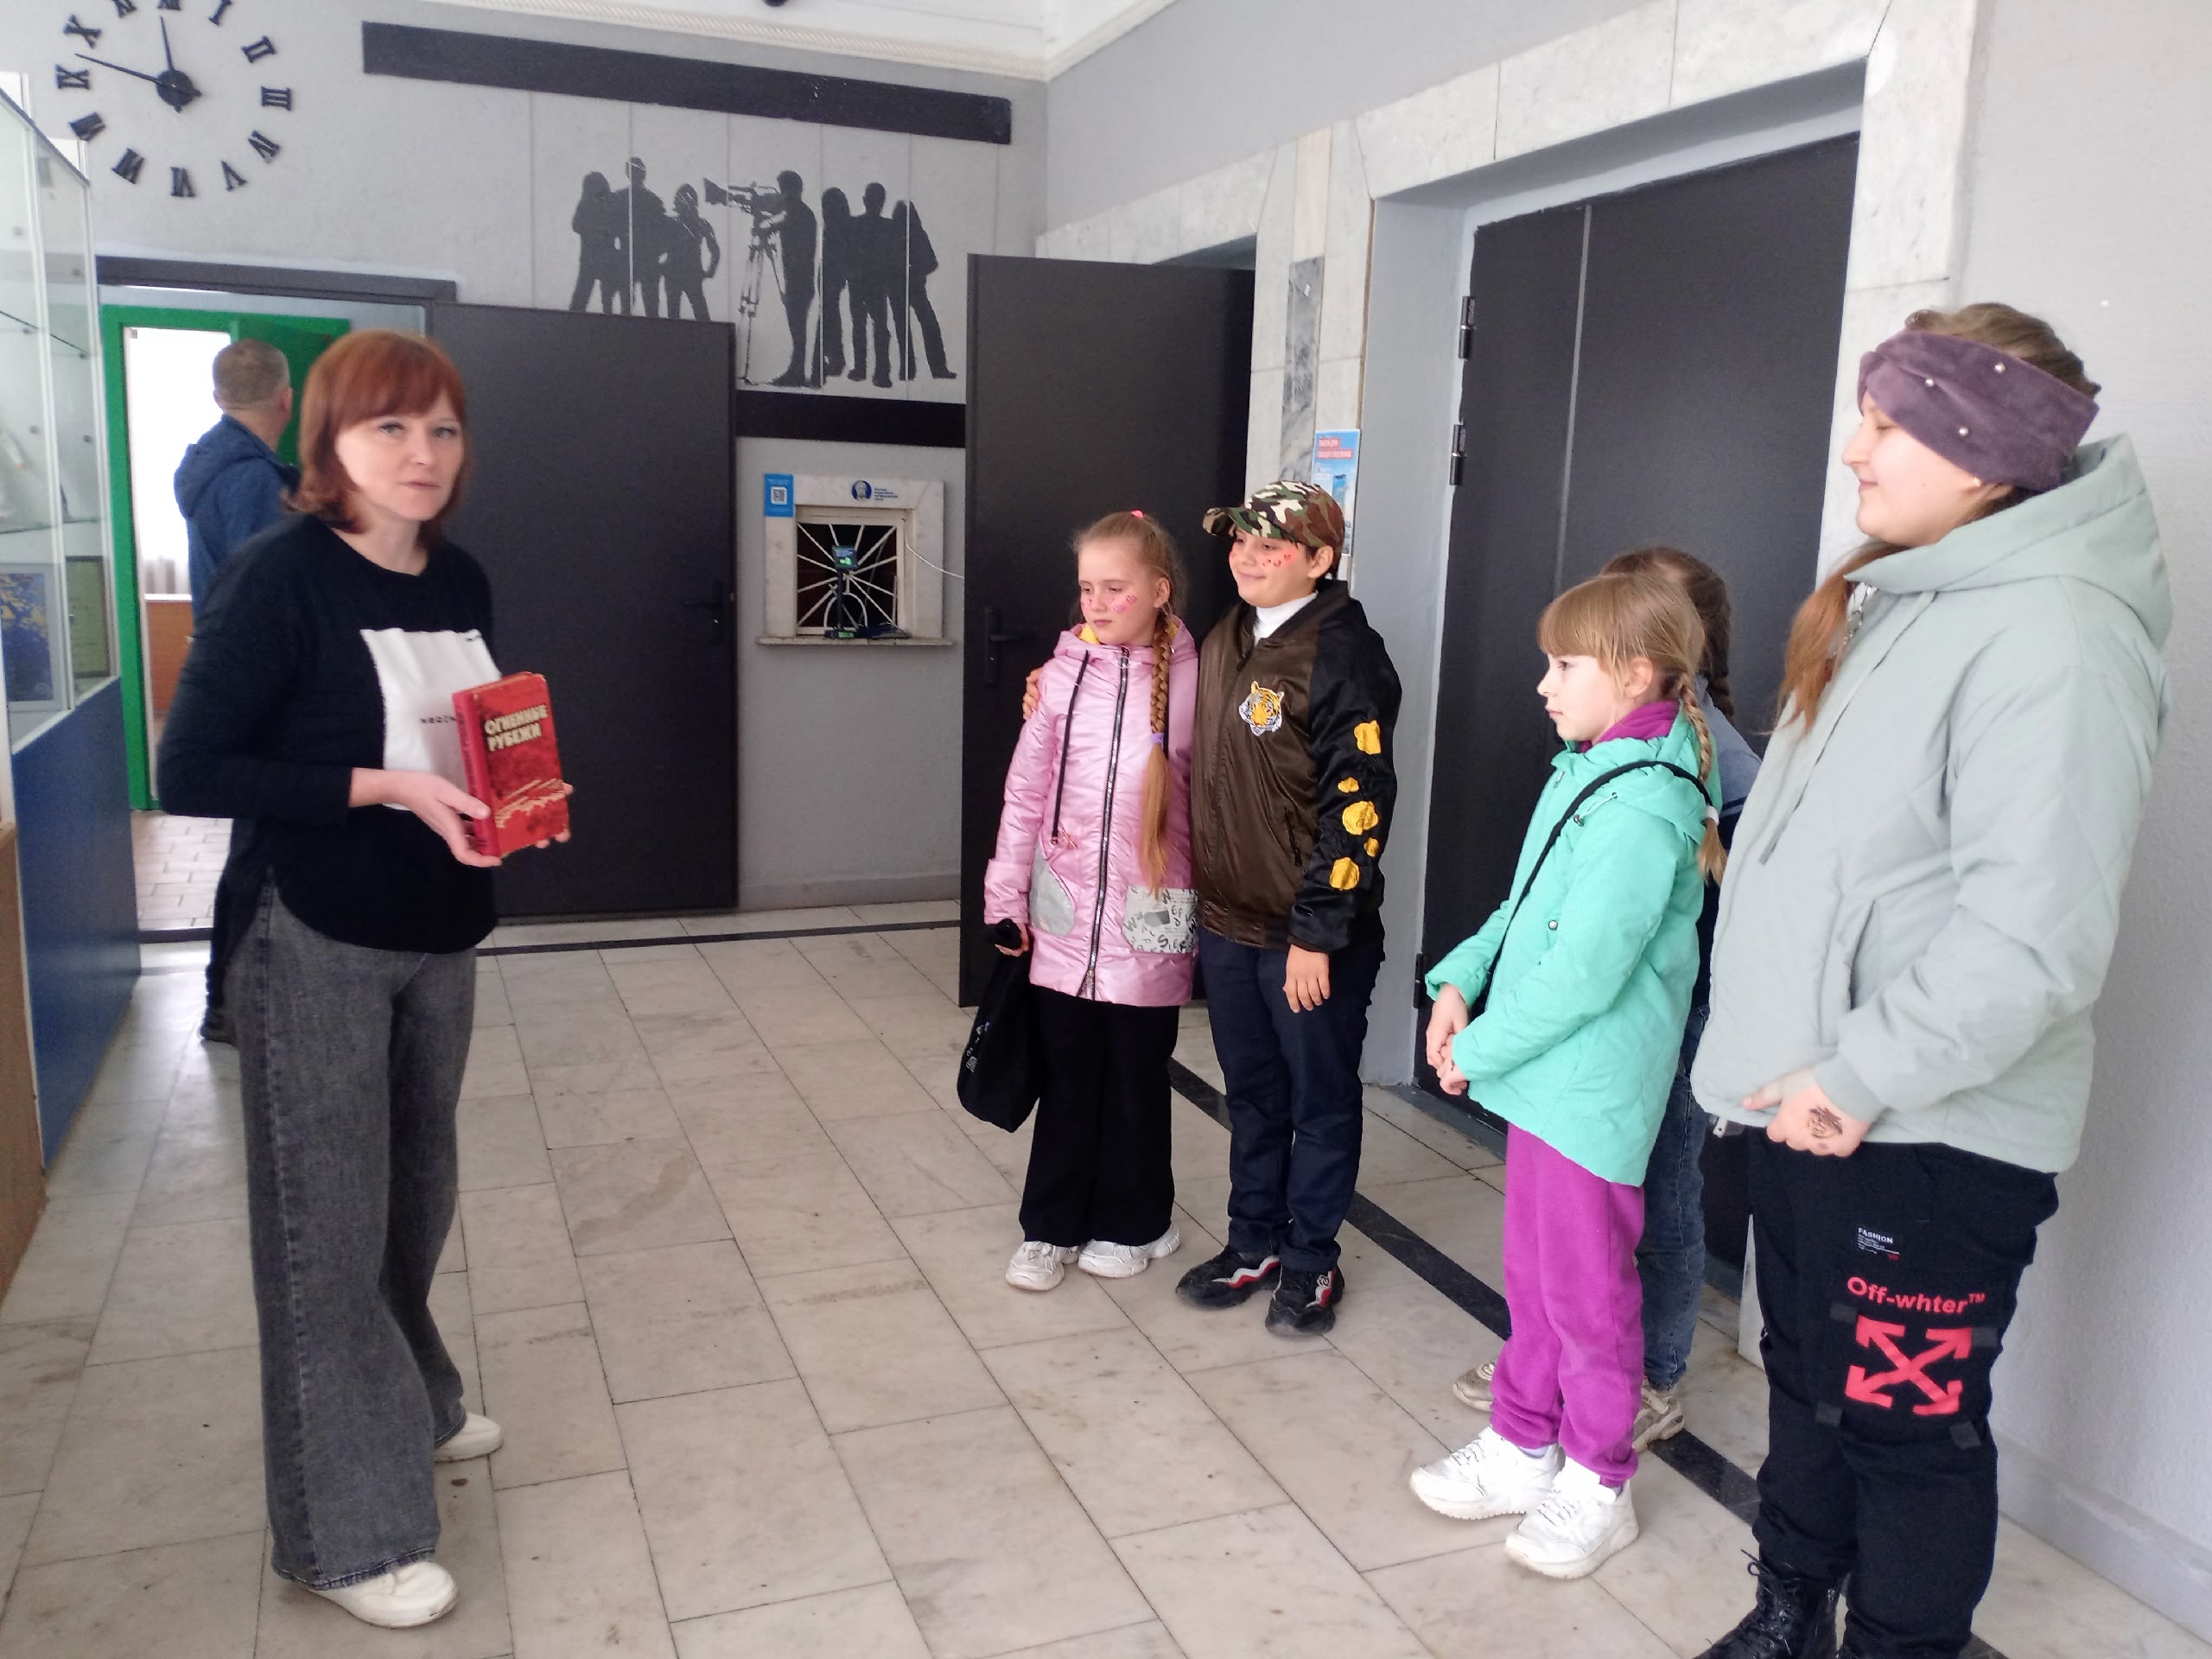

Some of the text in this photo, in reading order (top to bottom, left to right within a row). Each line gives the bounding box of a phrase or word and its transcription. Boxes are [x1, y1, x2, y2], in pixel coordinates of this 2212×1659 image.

[63, 14, 101, 48] X
[241, 35, 276, 63] II
[55, 64, 90, 89] IX
[261, 86, 292, 111] III
[221, 160, 247, 192] V
[1858, 1227, 1893, 1244] FASHION
